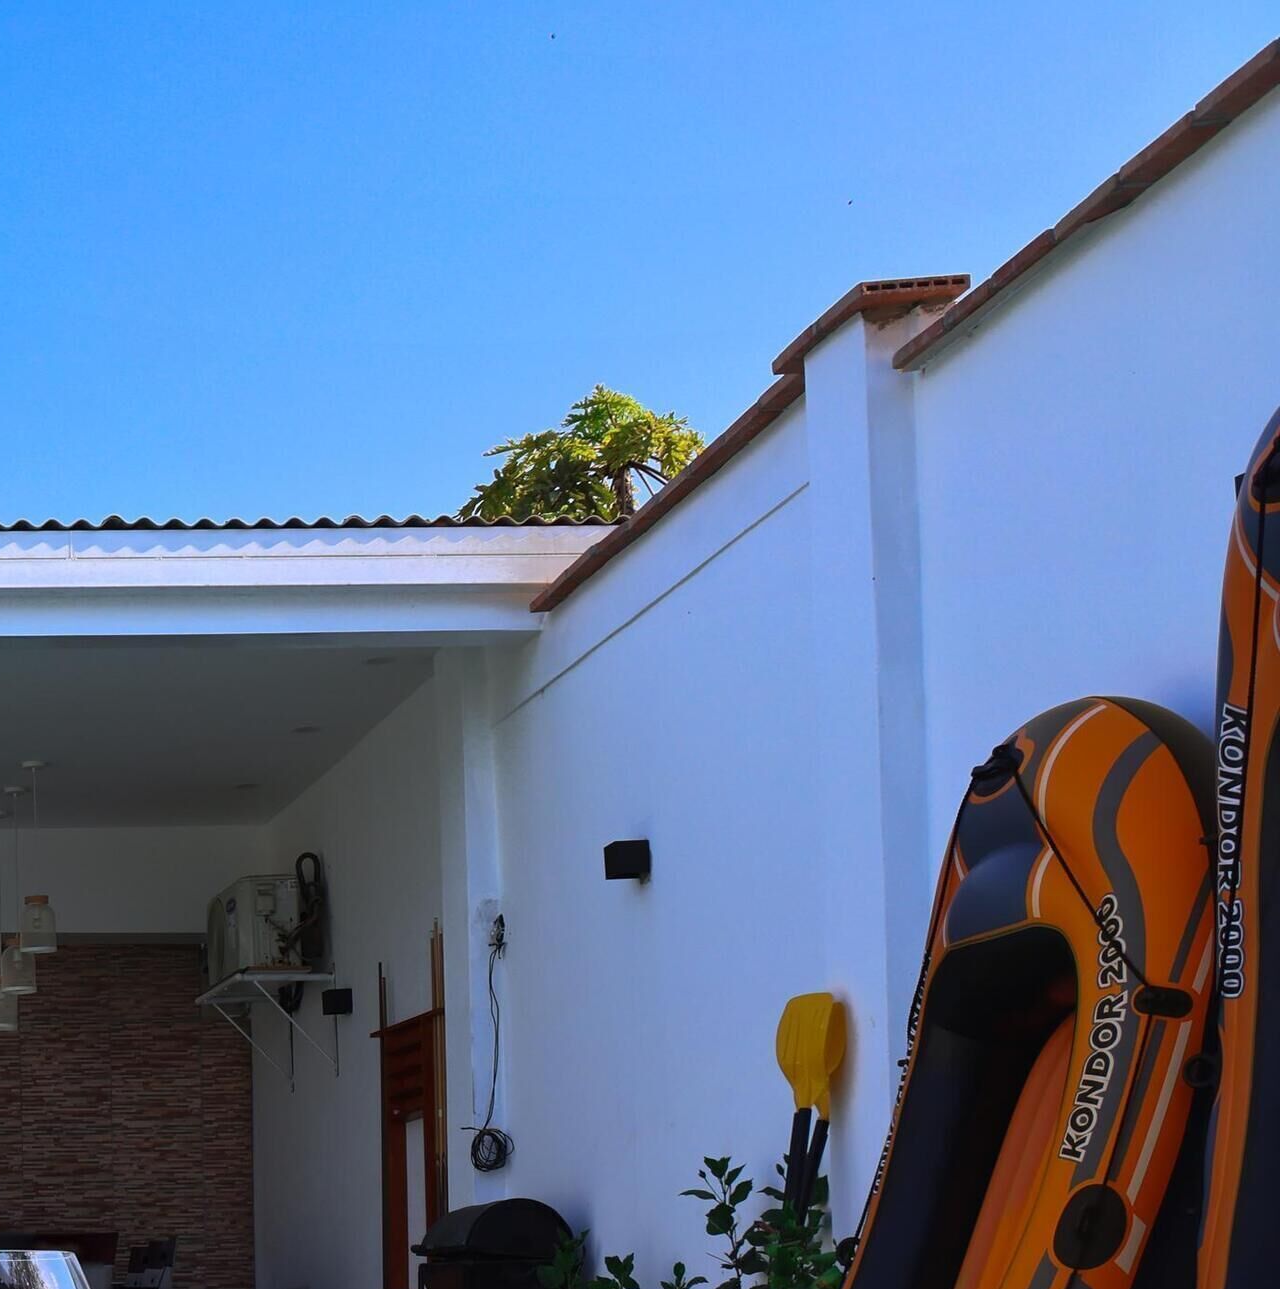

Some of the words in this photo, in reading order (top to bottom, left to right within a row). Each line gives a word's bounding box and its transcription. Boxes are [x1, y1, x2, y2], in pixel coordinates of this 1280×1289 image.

[1217, 702, 1249, 894] KONDOR
[1058, 990, 1129, 1163] KONDOR
[1096, 893, 1127, 989] 2000
[1217, 899, 1246, 1000] 2000
